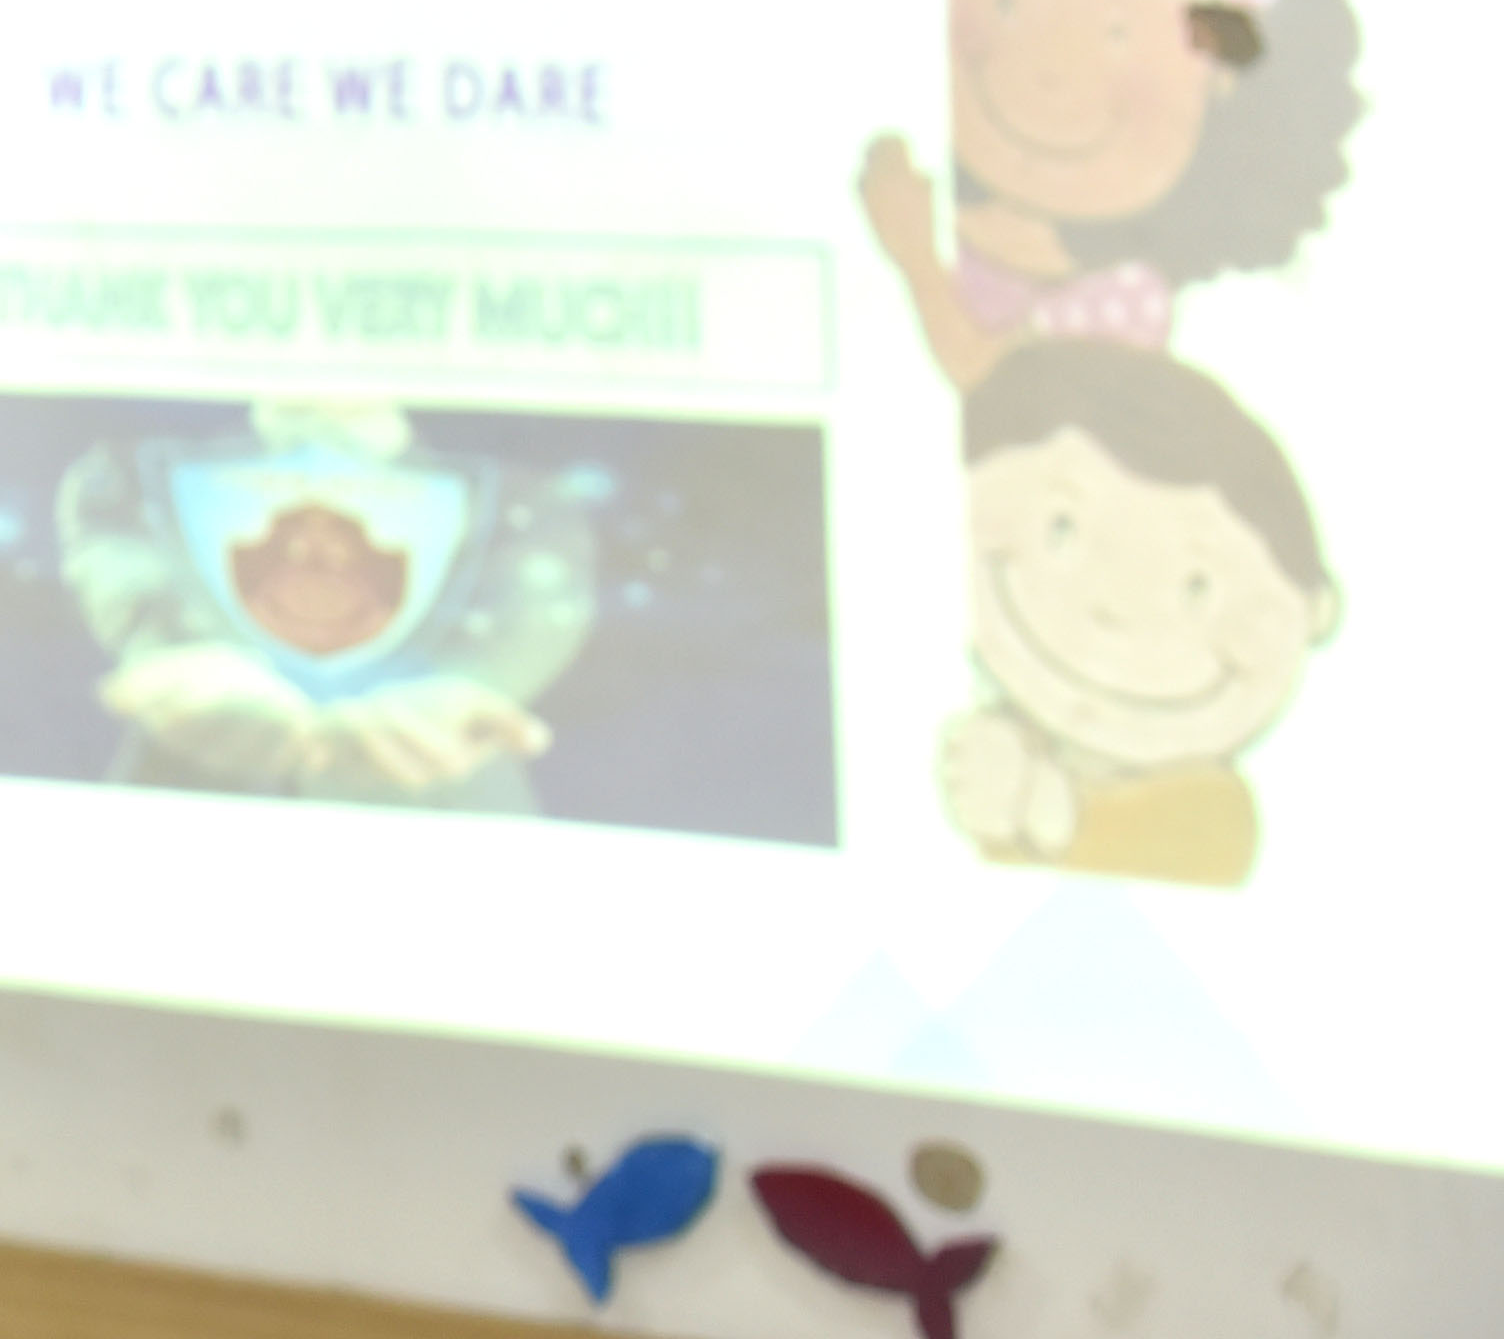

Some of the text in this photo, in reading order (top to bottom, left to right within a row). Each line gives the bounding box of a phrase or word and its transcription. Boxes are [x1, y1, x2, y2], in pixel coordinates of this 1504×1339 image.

[44, 53, 615, 132] WE CARE WE DARE
[180, 270, 303, 349] YOU
[312, 271, 463, 351] VERY
